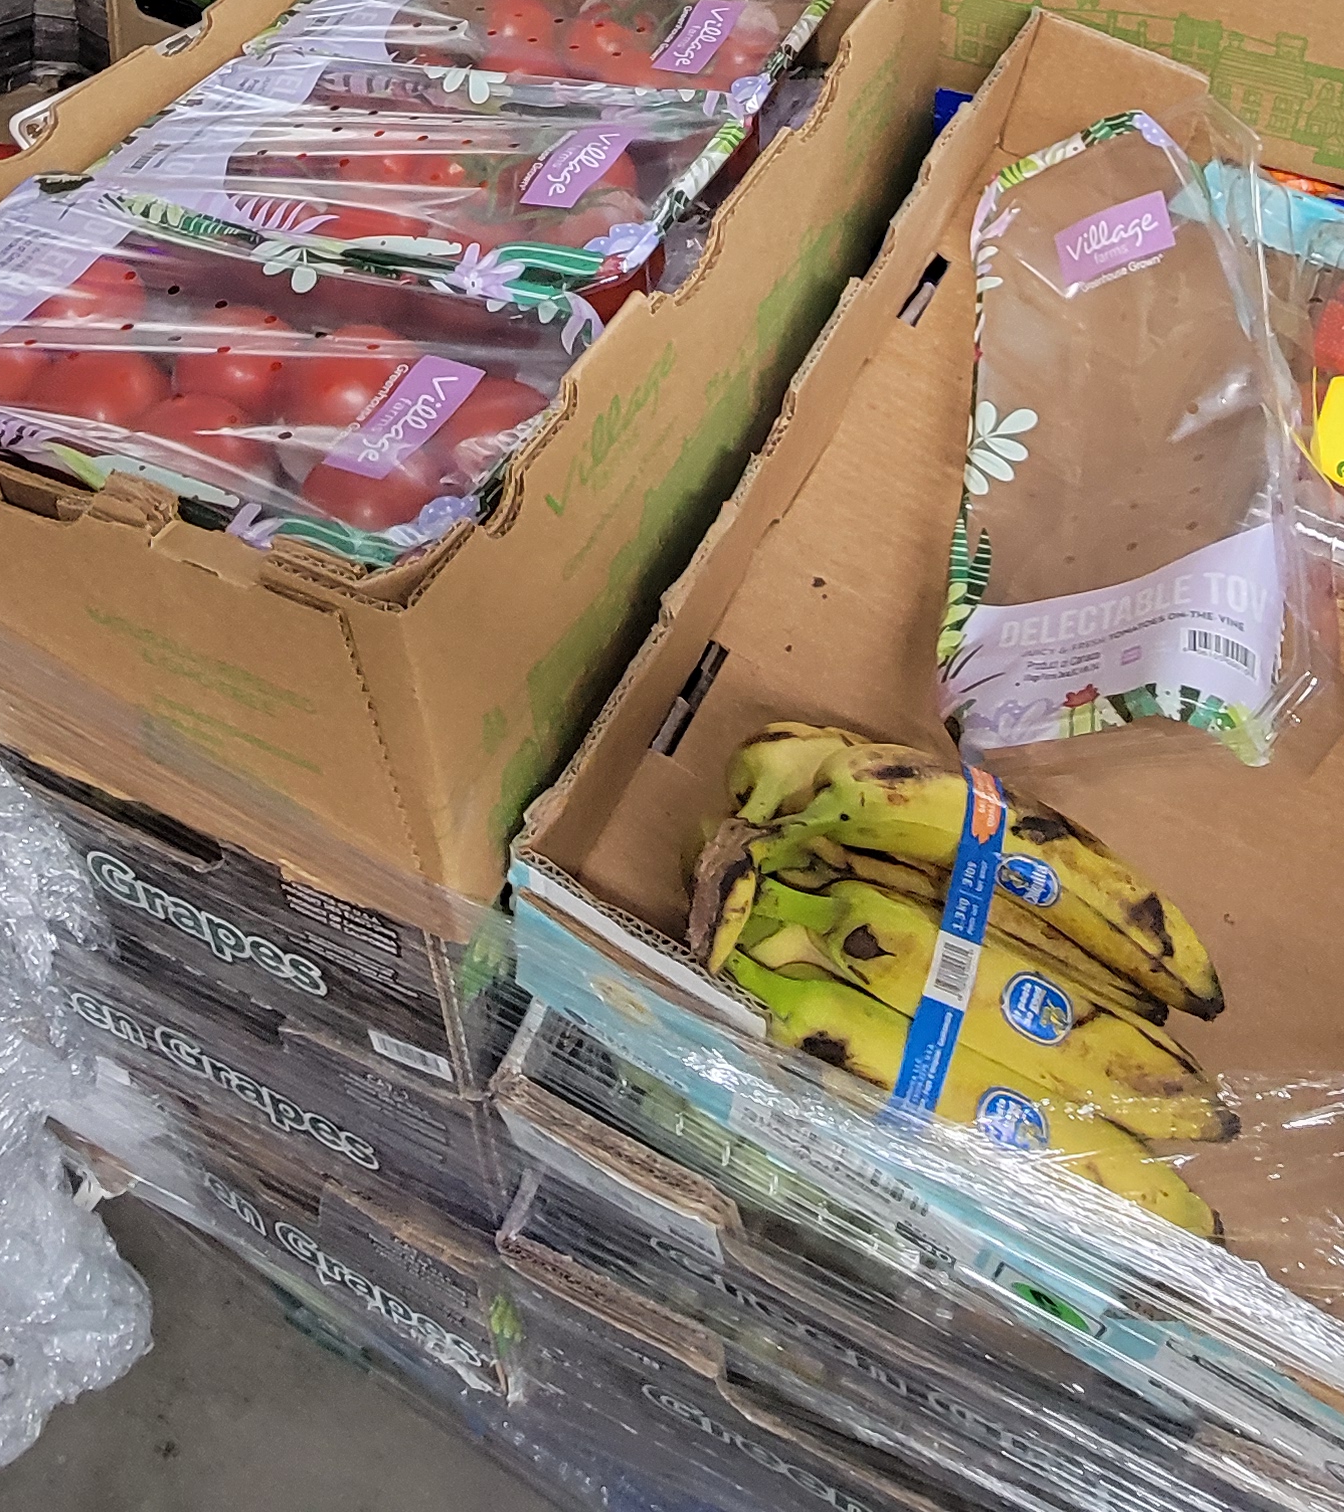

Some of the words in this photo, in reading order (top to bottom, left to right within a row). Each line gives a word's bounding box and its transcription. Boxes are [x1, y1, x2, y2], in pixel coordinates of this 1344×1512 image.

[673, 7, 730, 66] Village
[547, 133, 621, 197] Village
[1066, 213, 1158, 261] Village
[1093, 244, 1130, 264] farms
[357, 376, 459, 462] Village
[998, 574, 1193, 648] DELECTABLE
[1203, 572, 1268, 624] TOV
[1108, 615, 1165, 640] TOMATOES
[86, 850, 329, 997] Grapes
[154, 1025, 381, 1171] Grapes
[274, 1220, 482, 1368] Grapes
